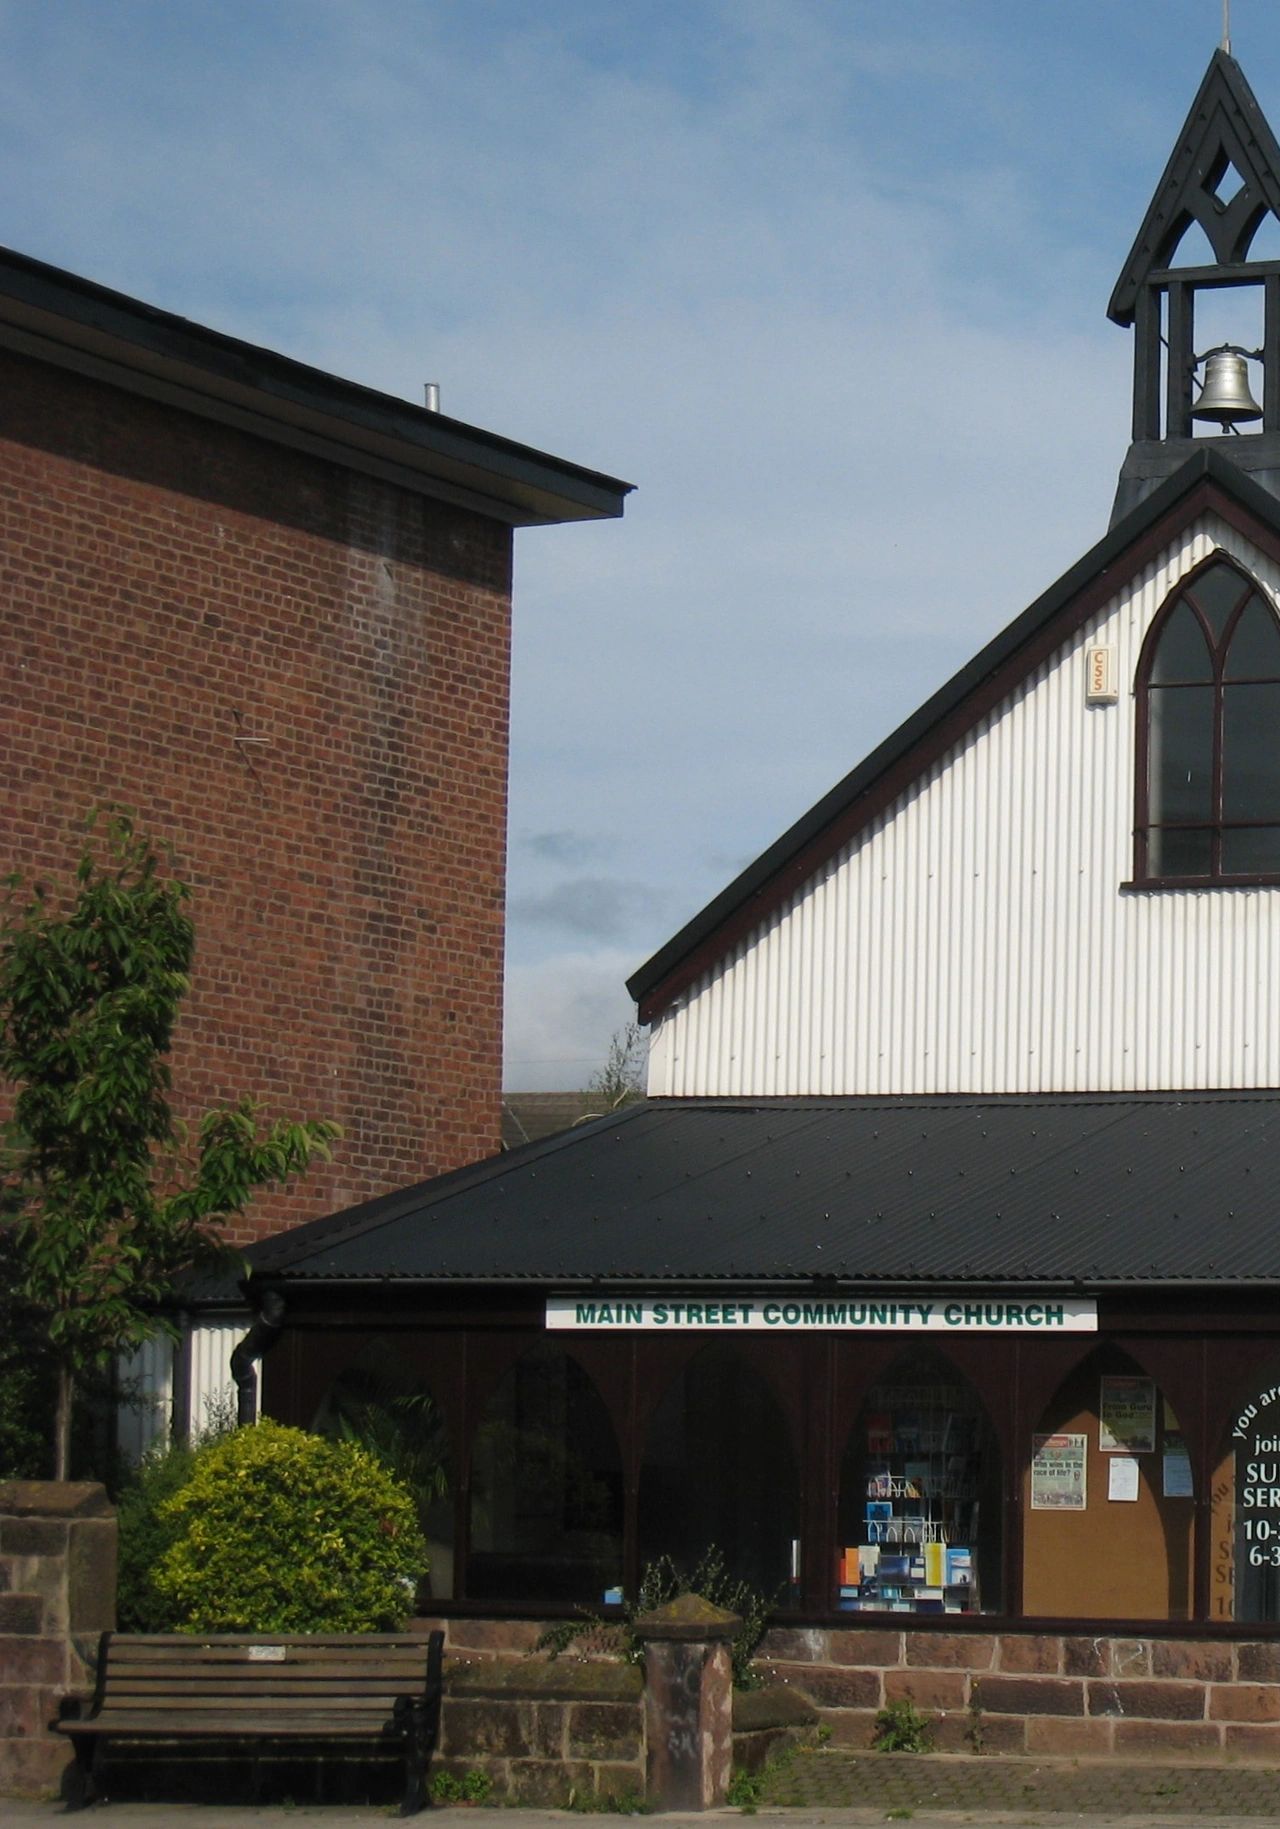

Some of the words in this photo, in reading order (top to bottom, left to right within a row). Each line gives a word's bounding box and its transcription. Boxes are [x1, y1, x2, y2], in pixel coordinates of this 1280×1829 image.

[575, 1303, 643, 1324] MAIN
[652, 1303, 754, 1325] STREET
[762, 1303, 934, 1325] COMMUNITY
[944, 1303, 1064, 1326] CHURCH
[1232, 1404, 1258, 1439] you
